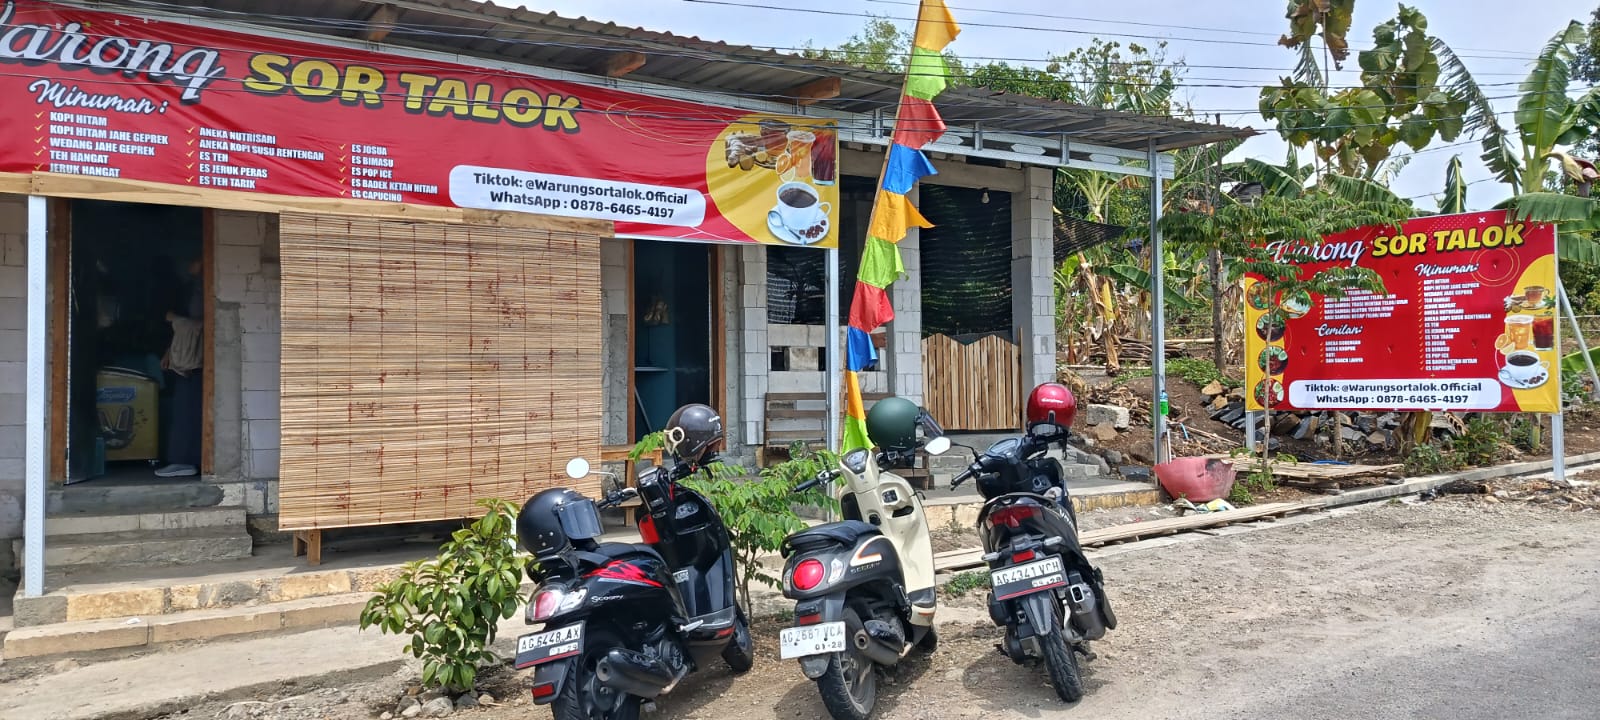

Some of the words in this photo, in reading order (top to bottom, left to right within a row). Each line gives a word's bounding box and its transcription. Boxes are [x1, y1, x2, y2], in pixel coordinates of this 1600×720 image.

[0, 1, 224, 100] arong
[245, 53, 384, 104] SOR
[400, 73, 582, 129] TALOK
[29, 80, 155, 113] Minuman
[50, 112, 74, 123] KOPI
[76, 115, 107, 126] HITAM
[50, 125, 74, 136] KOPI
[76, 127, 107, 139] HITAM
[109, 131, 131, 142] JAHE
[133, 133, 169, 145] GEPREK
[200, 127, 228, 139] ANEKA
[229, 131, 276, 145] NUTRISARI
[50, 138, 93, 150] WEDANG
[95, 142, 117, 152] JAHE
[119, 144, 155, 156] GEPREK
[200, 139, 228, 150] ANEKA
[230, 142, 250, 153] KOPI
[251, 145, 275, 156] SUSU
[276, 148, 324, 161] RENTENGAN
[352, 144, 361, 153] ES
[362, 145, 387, 155] JOSUA
[50, 150, 68, 161] TEH
[70, 152, 109, 164] HANGAT
[200, 151, 210, 161] ES
[212, 152, 229, 163] TEH
[352, 155, 361, 164] ES
[363, 157, 394, 167] BIMASU
[50, 163, 80, 175] JERUK
[82, 166, 120, 178] HANGAT
[200, 163, 210, 173] ES
[211, 164, 238, 175] JERUK
[240, 166, 268, 178] PERAS
[352, 167, 361, 176] ES
[363, 168, 378, 177] POP
[380, 170, 392, 179] ICE
[200, 175, 210, 185] ES
[212, 176, 228, 187] TEH
[230, 177, 256, 189] TARIK
[352, 178, 361, 187] ES
[362, 180, 388, 190] BADEK
[389, 182, 413, 192] KETAN
[414, 184, 438, 194] HITAM
[474, 173, 522, 188] Tiktok:
[525, 179, 688, 205] @Warungsortalok.Official
[352, 190, 361, 198] ES
[362, 192, 402, 202] CAPUCINO
[490, 191, 560, 209] WhatsApp
[570, 199, 674, 219] 0878-6465-4197
[1372, 234, 1427, 257] SOR
[1433, 223, 1524, 251] TALOK
[1305, 383, 1340, 392] Tiktok:
[1341, 382, 1482, 393] @Warungsortalok.Official
[1316, 395, 1369, 404] WhatsApp
[1377, 395, 1468, 404] 0878-6465-4197
[522, 638, 534, 650] AG
[537, 631, 561, 646] 6448
[566, 626, 579, 640] AX
